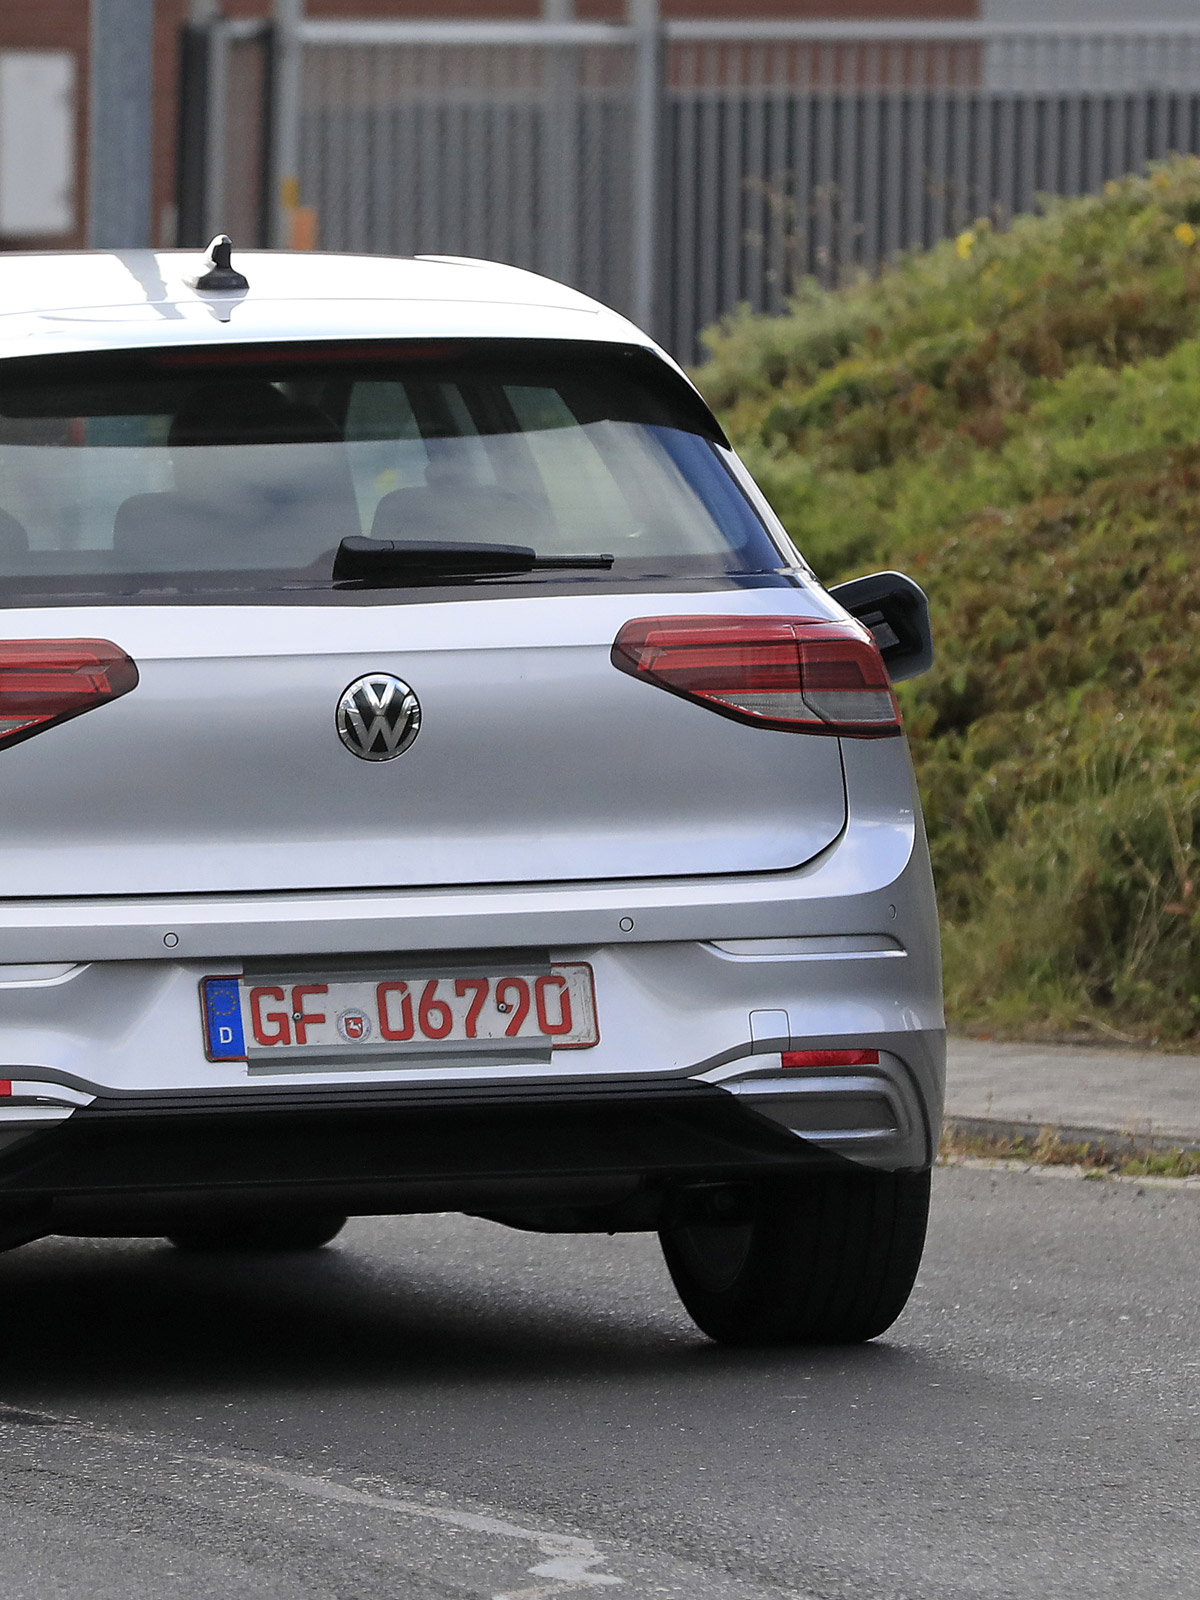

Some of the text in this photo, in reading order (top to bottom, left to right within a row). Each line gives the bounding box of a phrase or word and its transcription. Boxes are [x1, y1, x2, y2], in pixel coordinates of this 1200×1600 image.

[219, 1027, 233, 1043] D
[249, 984, 329, 1046] GF
[376, 975, 573, 1041] 06790
